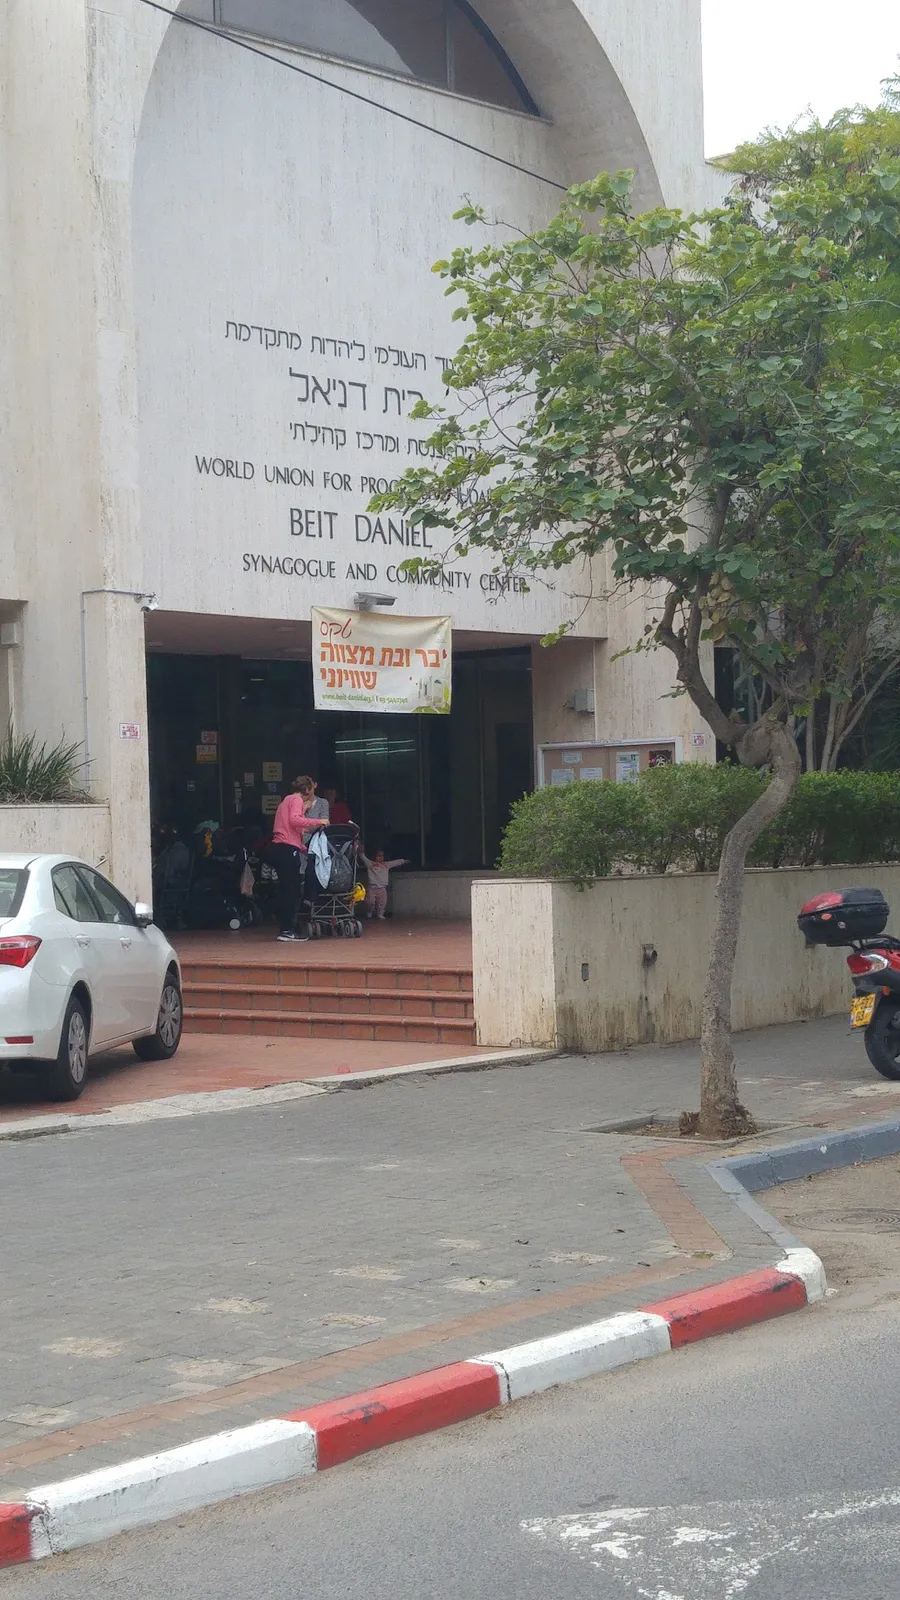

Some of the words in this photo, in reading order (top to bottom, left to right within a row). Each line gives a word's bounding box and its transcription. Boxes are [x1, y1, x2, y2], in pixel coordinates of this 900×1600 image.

[224, 320, 302, 351] מתקדמת
[310, 336, 366, 361] ליהדות
[374, 345, 426, 371] העולמי
[289, 367, 367, 411] דניאל
[289, 421, 347, 451] קהילתי
[356, 431, 400, 453] ומרכז
[195, 455, 255, 480] WORLD
[264, 464, 315, 488] UNION
[323, 471, 353, 492] FOR
[290, 507, 338, 539] BEIT
[355, 514, 433, 548] DANIEL
[242, 553, 336, 579] SYNAGOGUE
[345, 562, 378, 581] AND
[386, 565, 472, 589] COMMUNITY
[480, 573, 526, 593] CENTER
[320, 642, 375, 666] מצווה
[379, 647, 411, 668] ובת
[415, 648, 441, 668] בר
[319, 667, 378, 690] שוויוני
